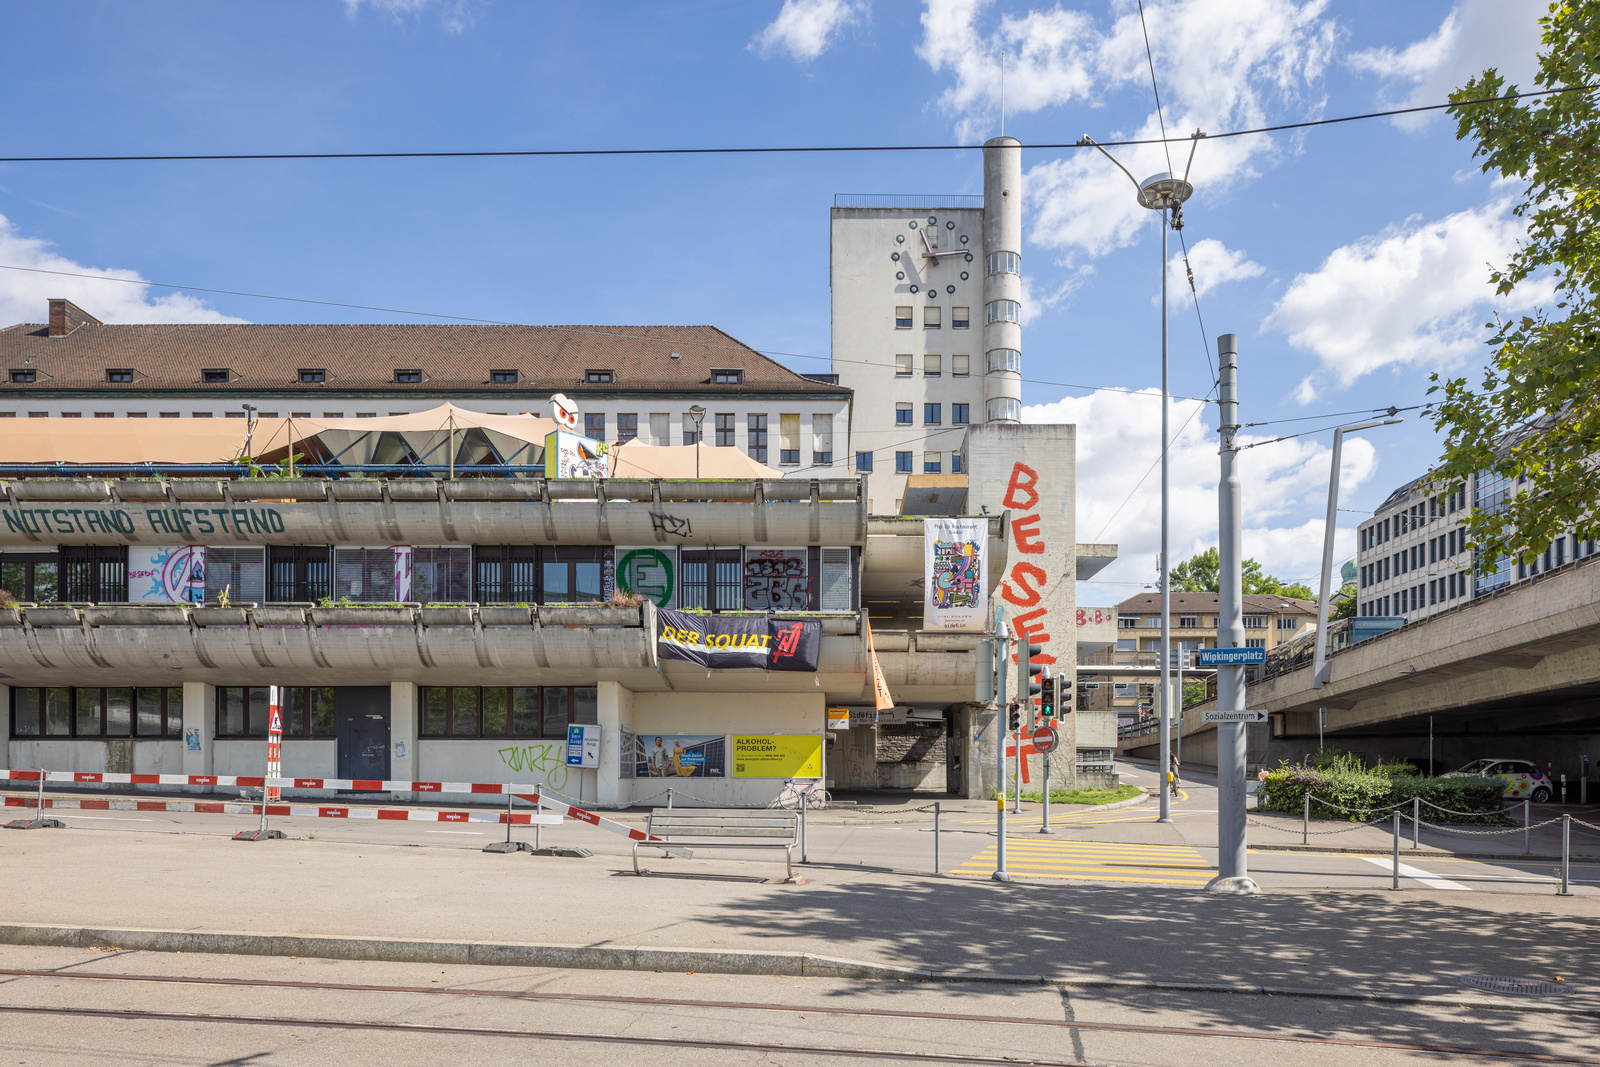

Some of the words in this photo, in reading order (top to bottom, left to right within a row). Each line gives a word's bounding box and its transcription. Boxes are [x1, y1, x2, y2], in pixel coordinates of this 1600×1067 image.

[2, 509, 135, 534] NOTSTAND
[146, 508, 285, 534] AUFSTAND
[662, 626, 700, 646] DER
[704, 634, 772, 651] SQUAT
[1202, 651, 1262, 662] Wipkingerplatz
[1206, 712, 1254, 720] Sozialzentrum
